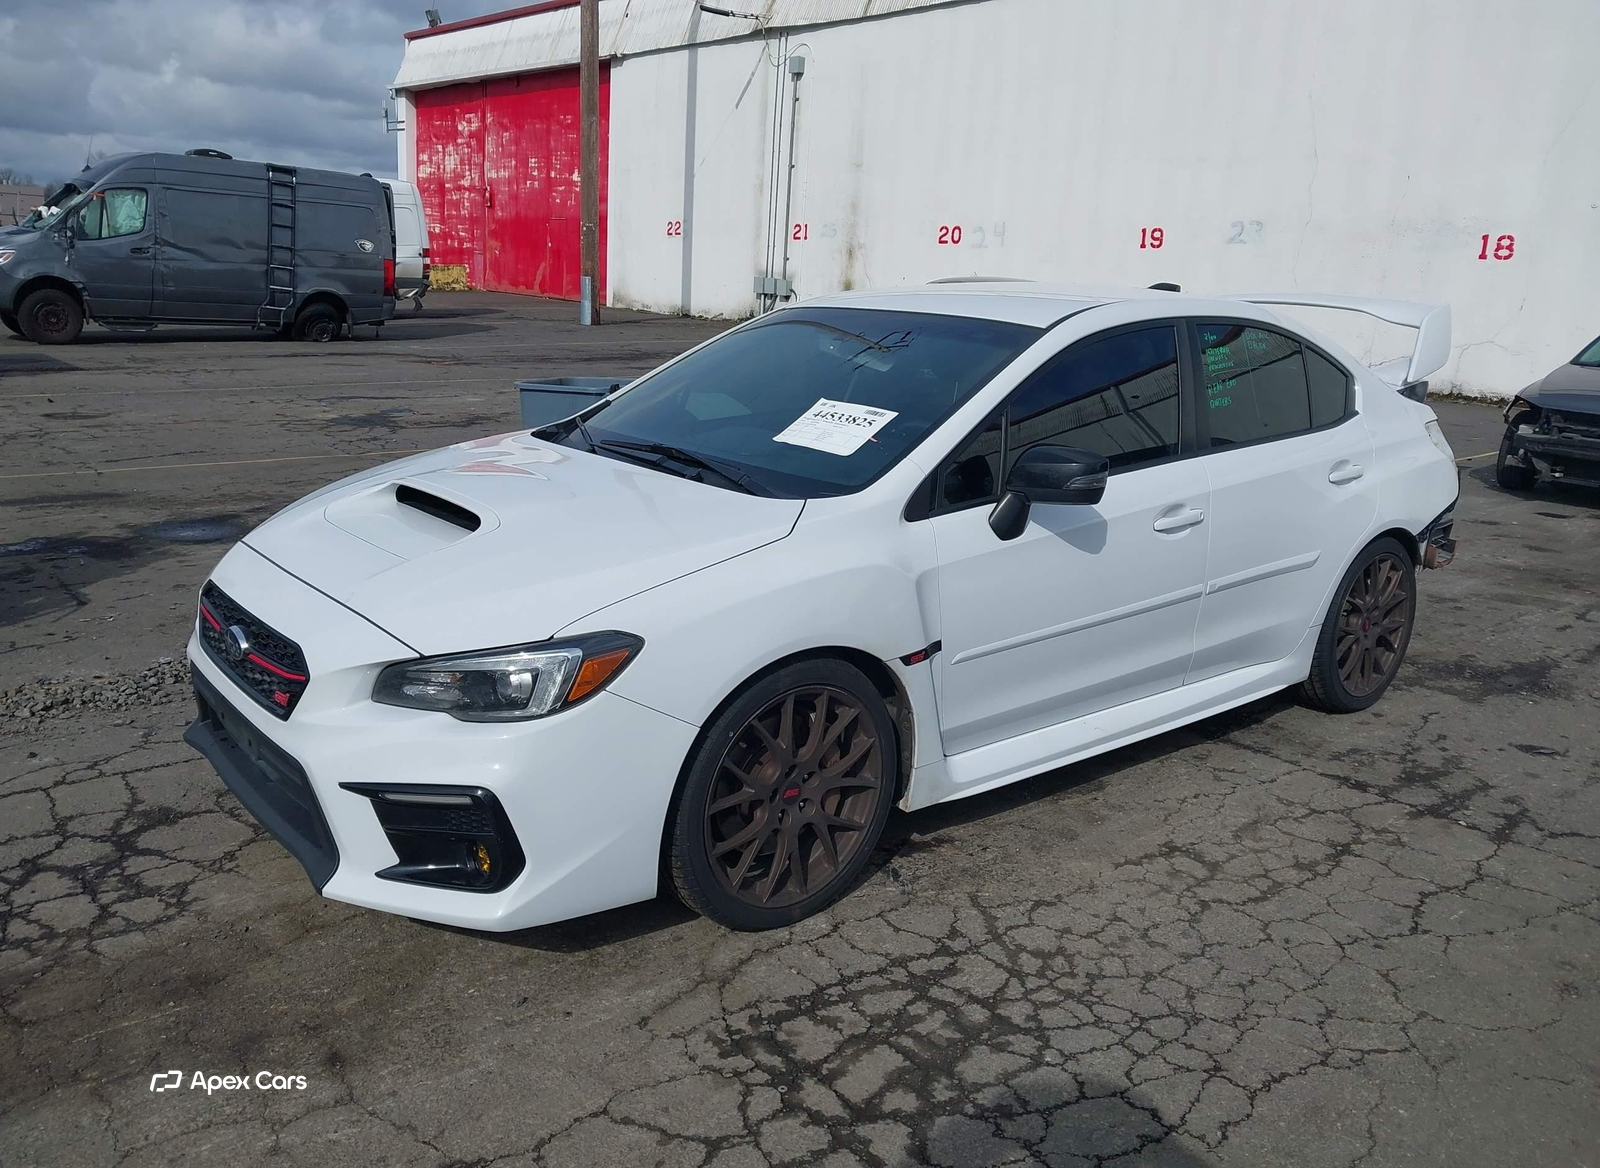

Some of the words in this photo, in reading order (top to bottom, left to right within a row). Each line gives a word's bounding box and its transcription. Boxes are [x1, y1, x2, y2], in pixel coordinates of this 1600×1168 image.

[666, 221, 682, 236] 22
[793, 224, 808, 240] 21
[938, 225, 962, 245] 20
[1139, 227, 1164, 249] 19
[1478, 233, 1515, 261] 18
[812, 409, 877, 428] 44533825
